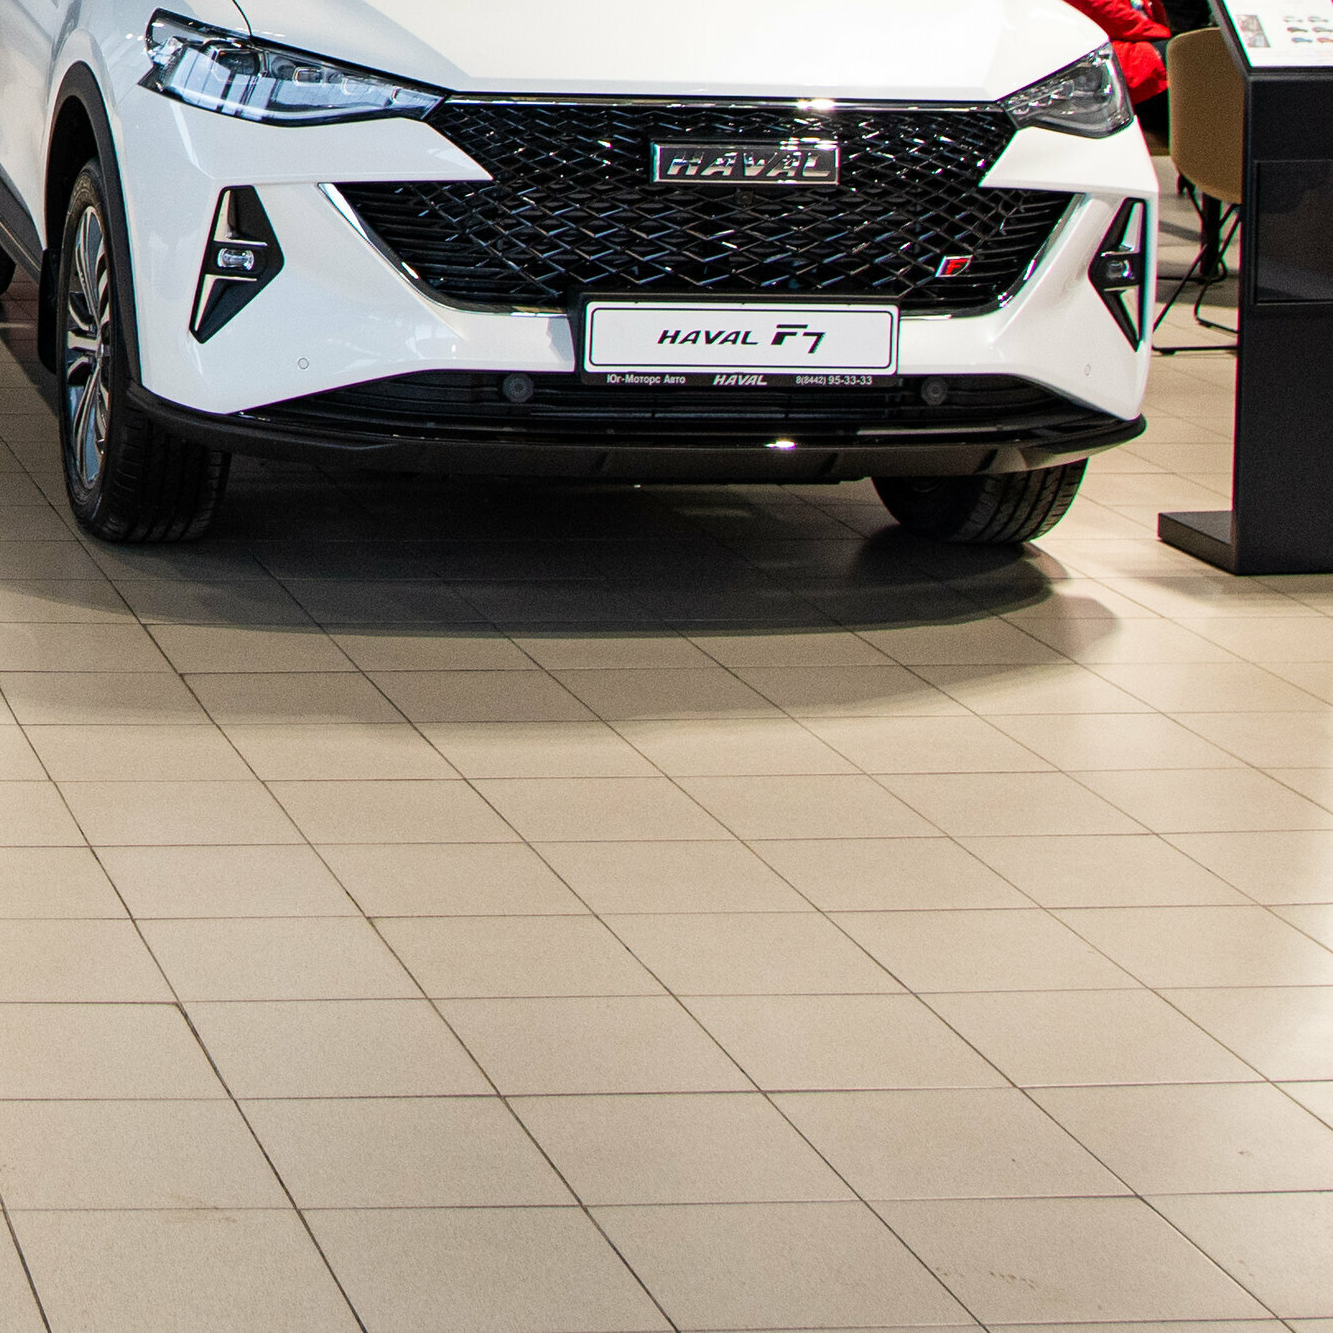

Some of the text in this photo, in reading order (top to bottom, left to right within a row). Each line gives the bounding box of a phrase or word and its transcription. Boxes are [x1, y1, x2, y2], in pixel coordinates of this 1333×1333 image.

[666, 151, 832, 178] HAVAL
[945, 258, 969, 275] F
[656, 323, 827, 354] HAVAL F7
[606, 373, 686, 385] Юг-Моторс Авто
[713, 374, 768, 385] HAVAL
[828, 375, 873, 385] 95-33-33
